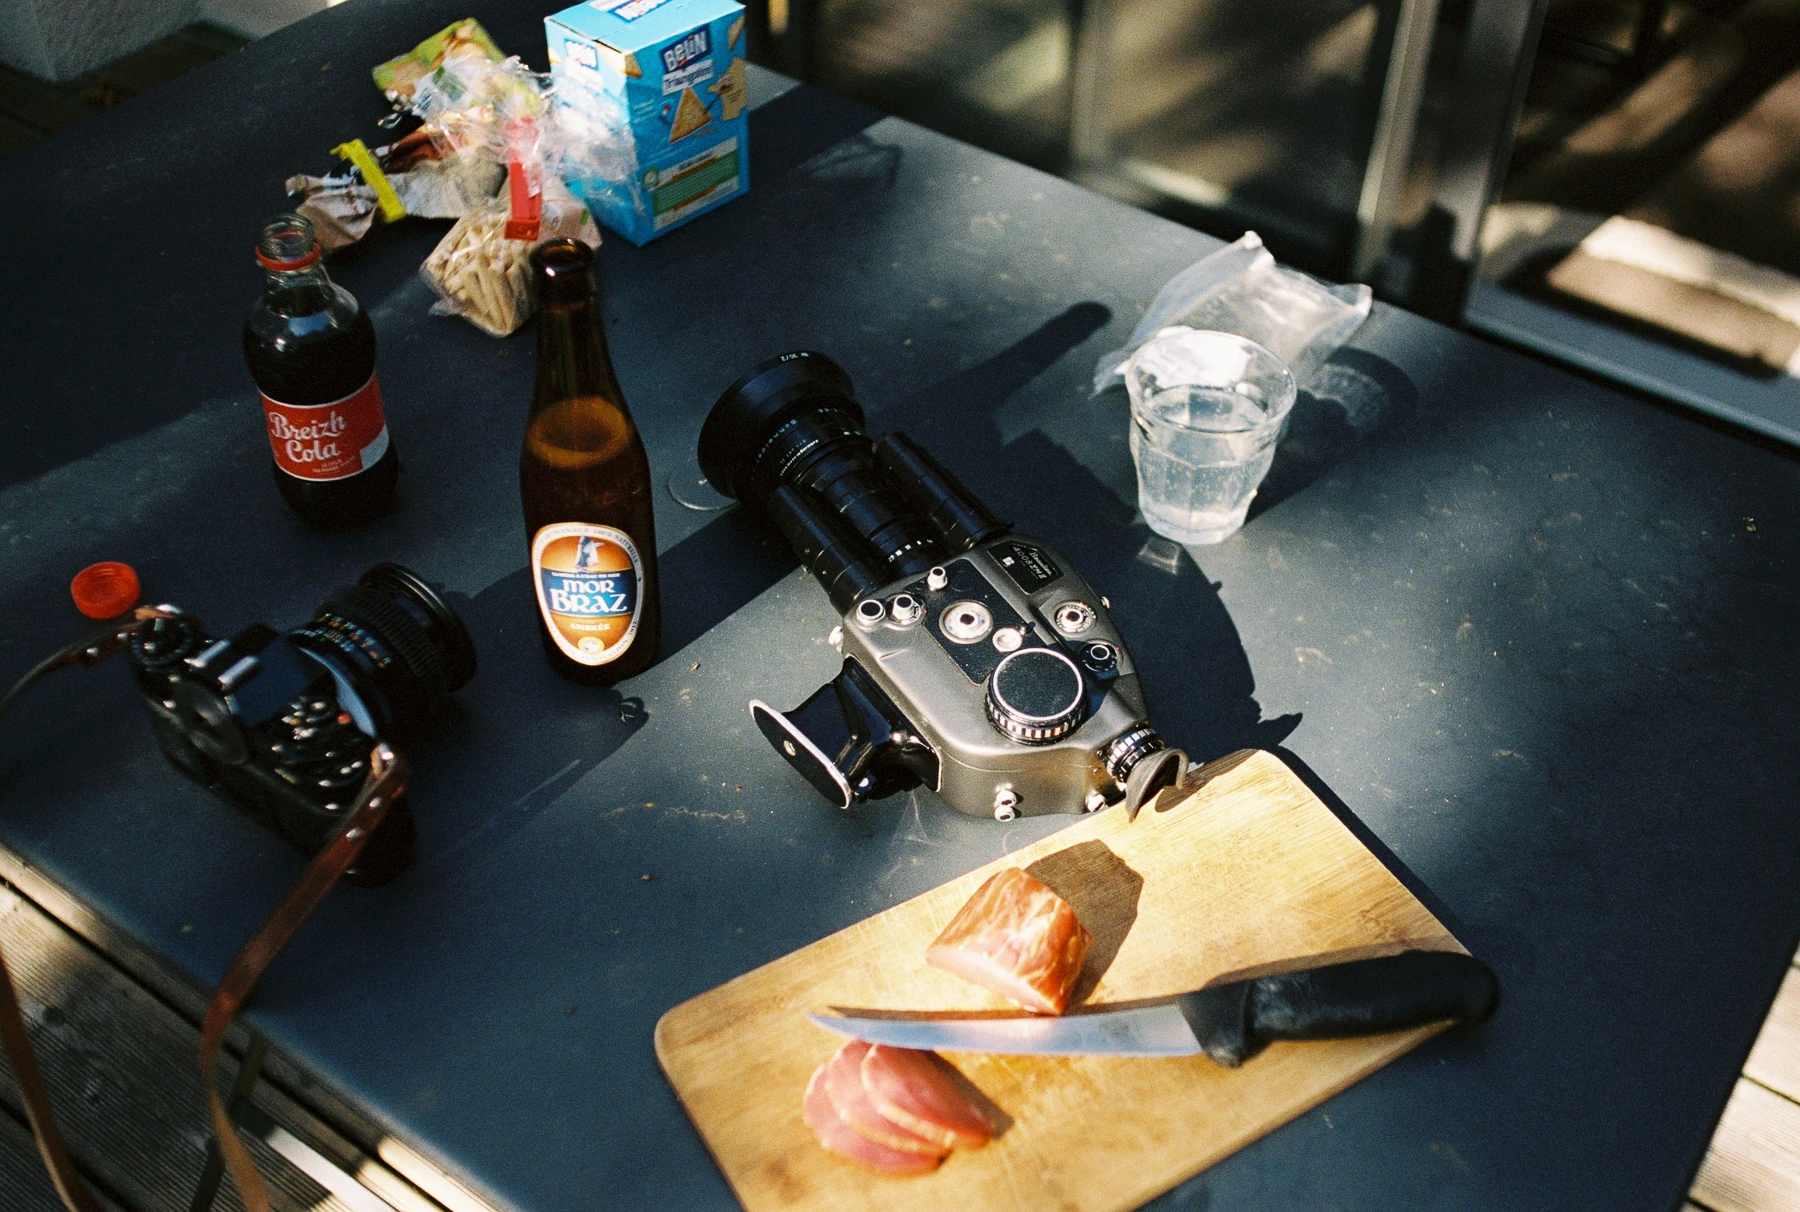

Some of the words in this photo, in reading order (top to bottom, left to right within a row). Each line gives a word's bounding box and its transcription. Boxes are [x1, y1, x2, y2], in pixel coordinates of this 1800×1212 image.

[268, 410, 346, 440] Breizh
[285, 440, 340, 463] Cola
[562, 579, 616, 594] MOR
[549, 588, 628, 614] BRAZ
